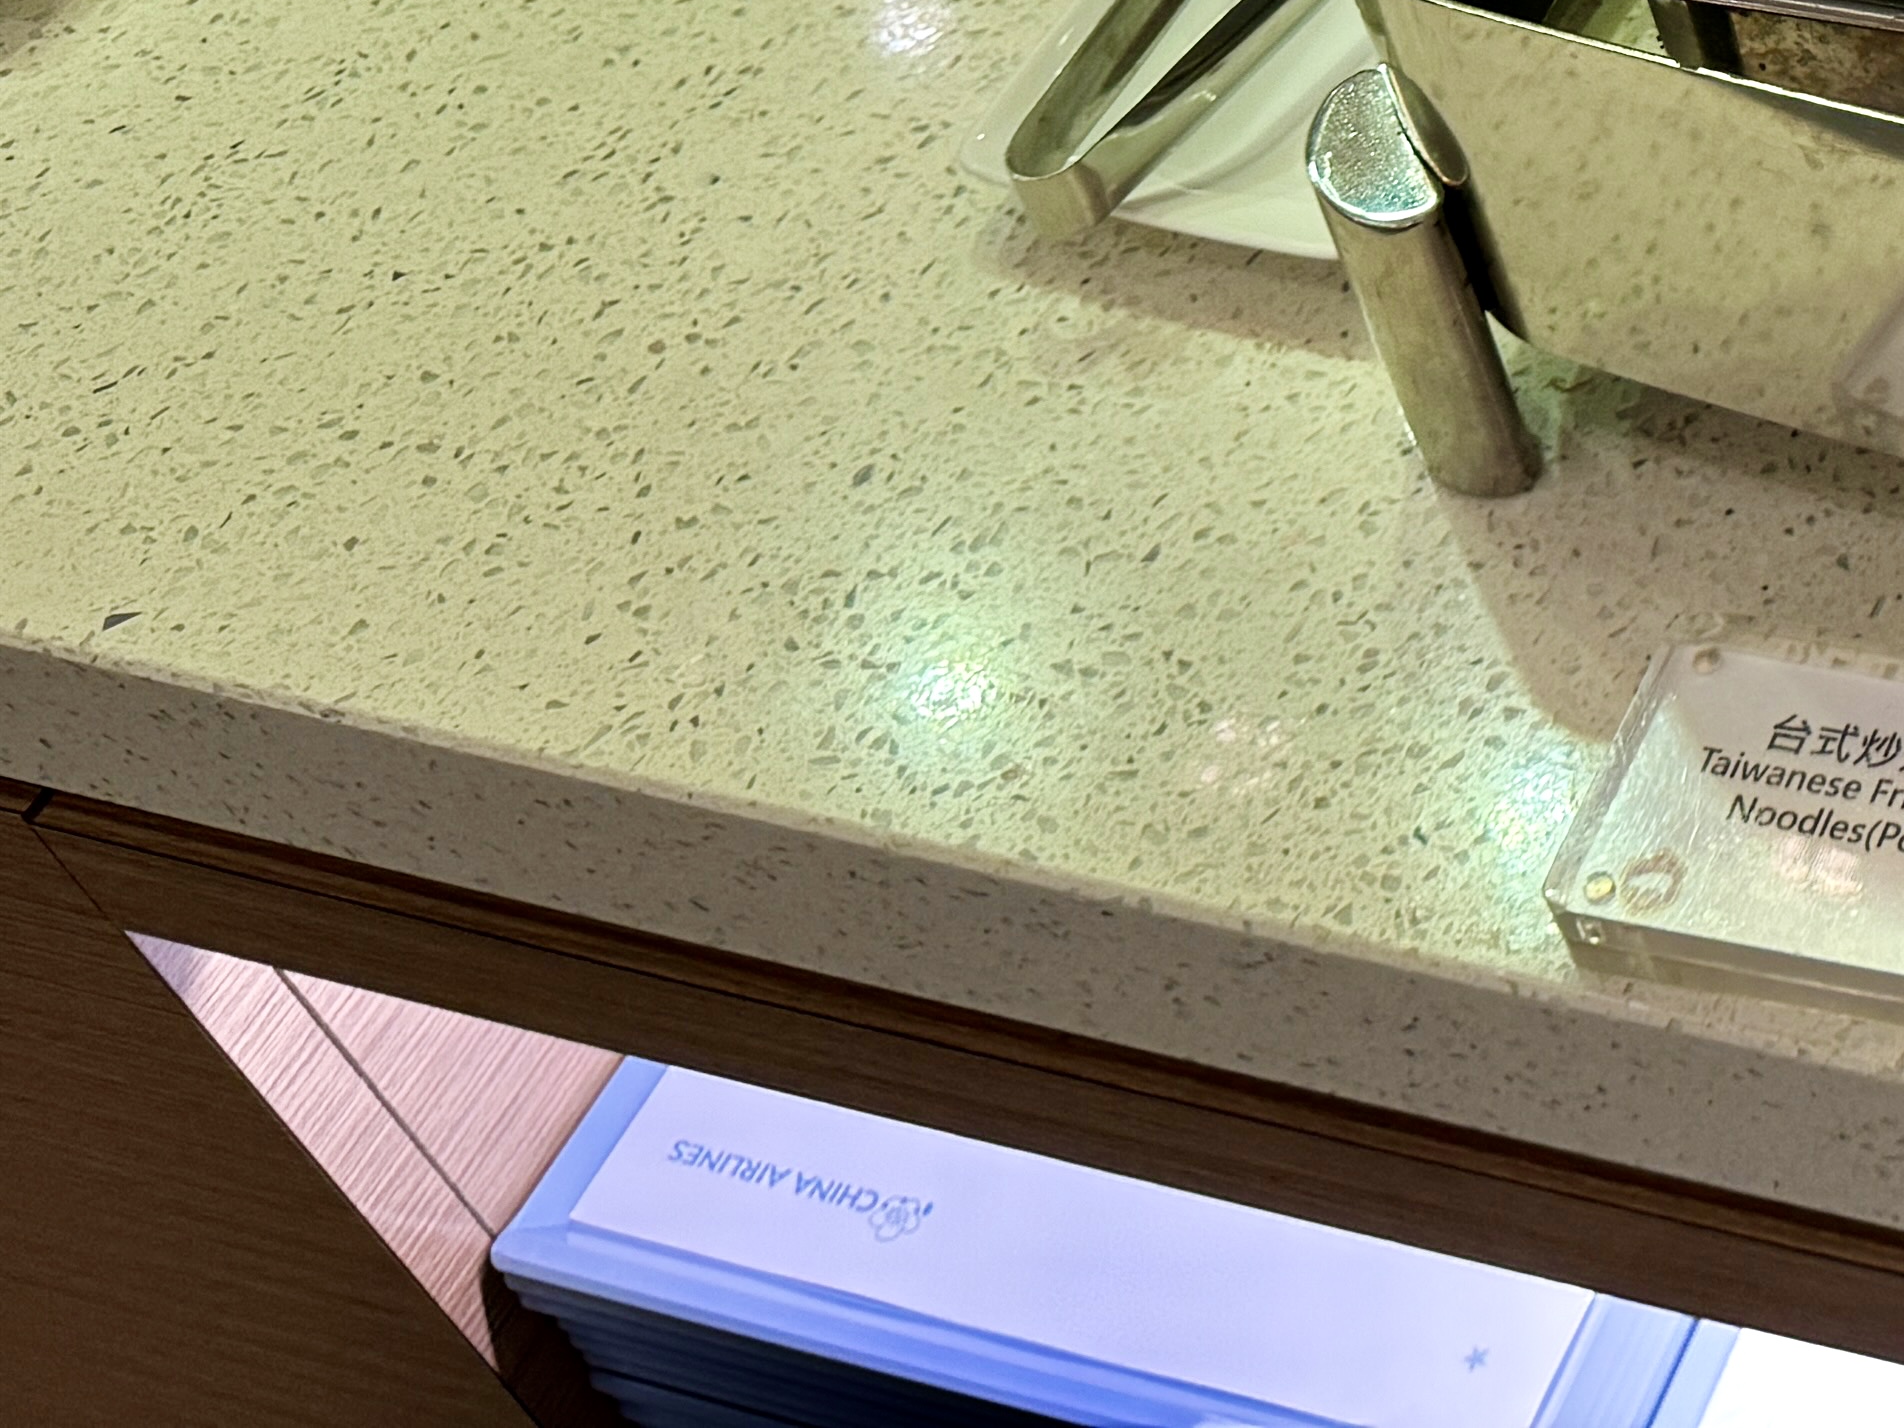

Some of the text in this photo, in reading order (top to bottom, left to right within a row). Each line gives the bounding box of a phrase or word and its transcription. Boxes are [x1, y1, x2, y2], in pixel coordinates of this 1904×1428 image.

[1700, 745, 1863, 801] Taiwanese
[666, 1138, 881, 1214] CHINA AIRLINES
